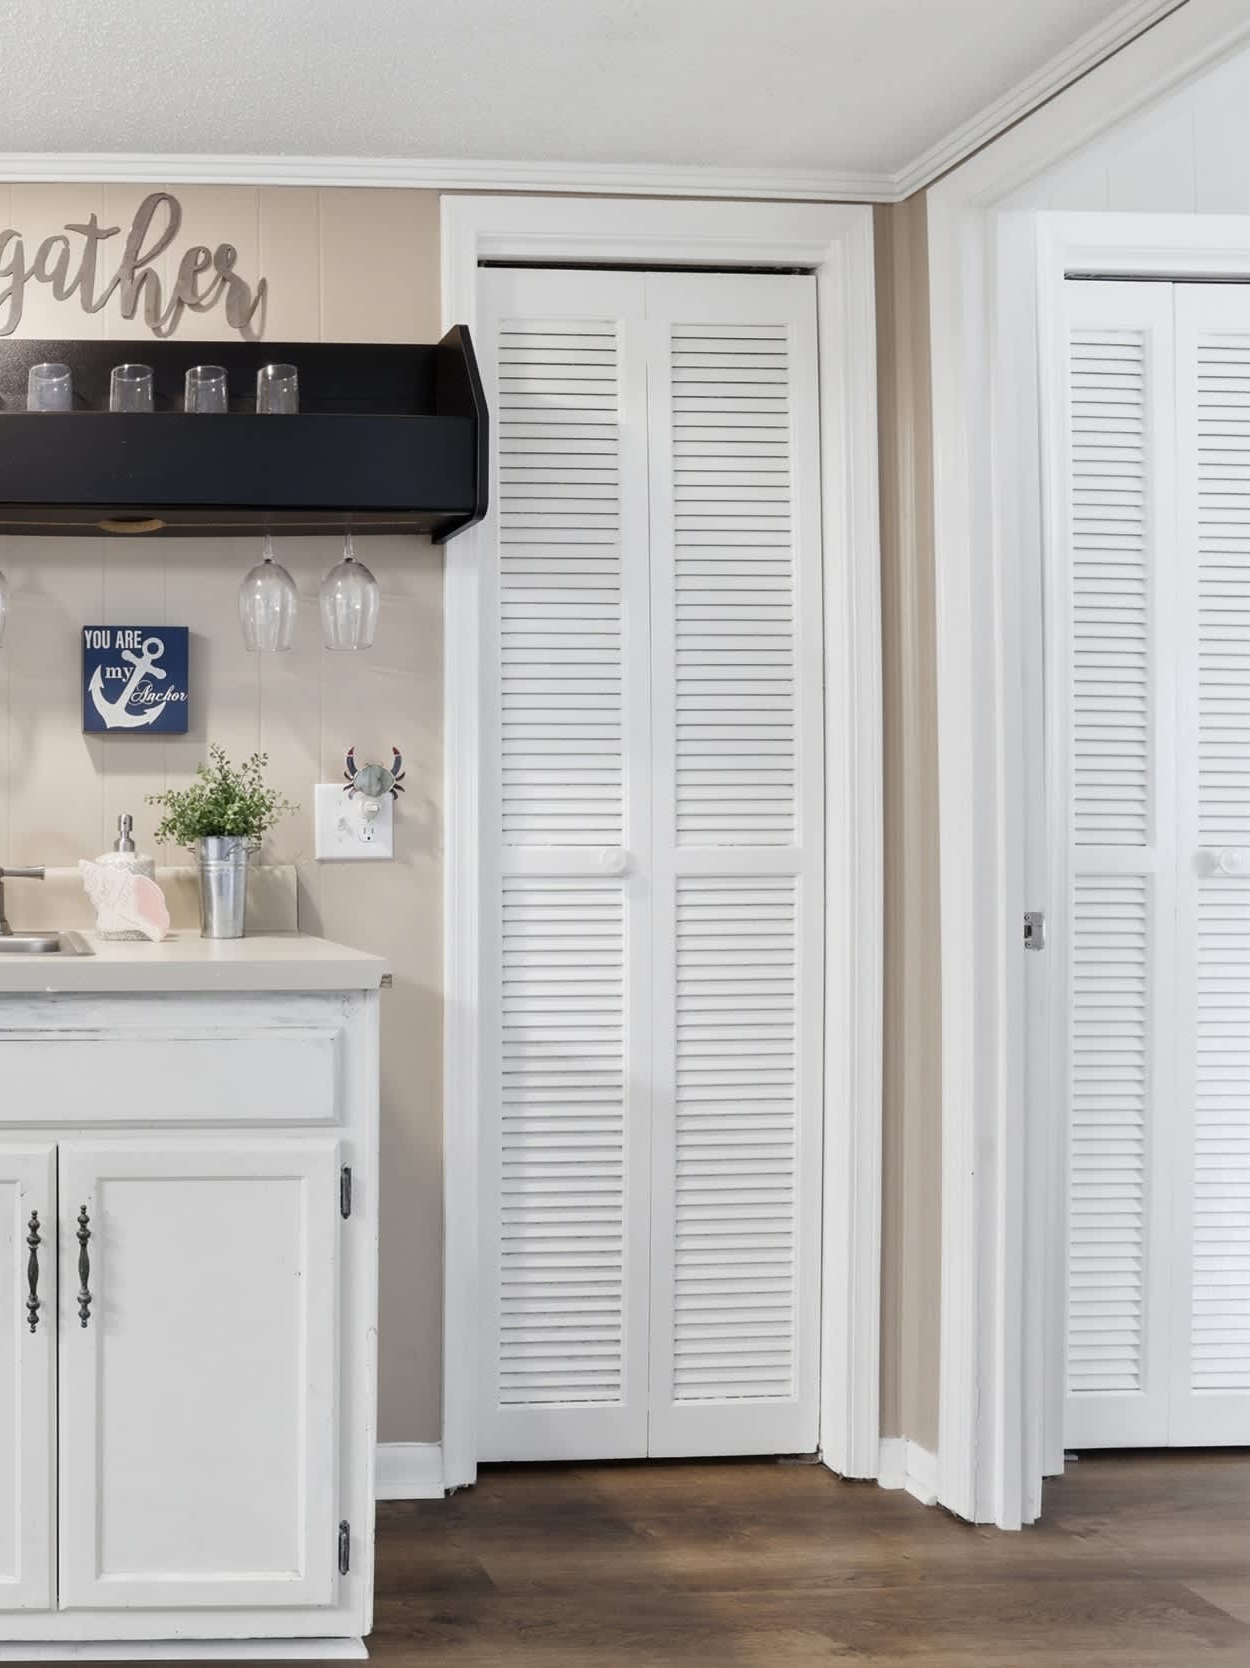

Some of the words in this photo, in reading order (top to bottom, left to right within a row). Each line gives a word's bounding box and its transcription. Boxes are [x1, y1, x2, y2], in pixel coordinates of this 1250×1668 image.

[84, 630, 110, 649] YOU
[115, 630, 142, 649] ARE
[105, 666, 134, 682] my
[128, 680, 190, 706] Anchor
